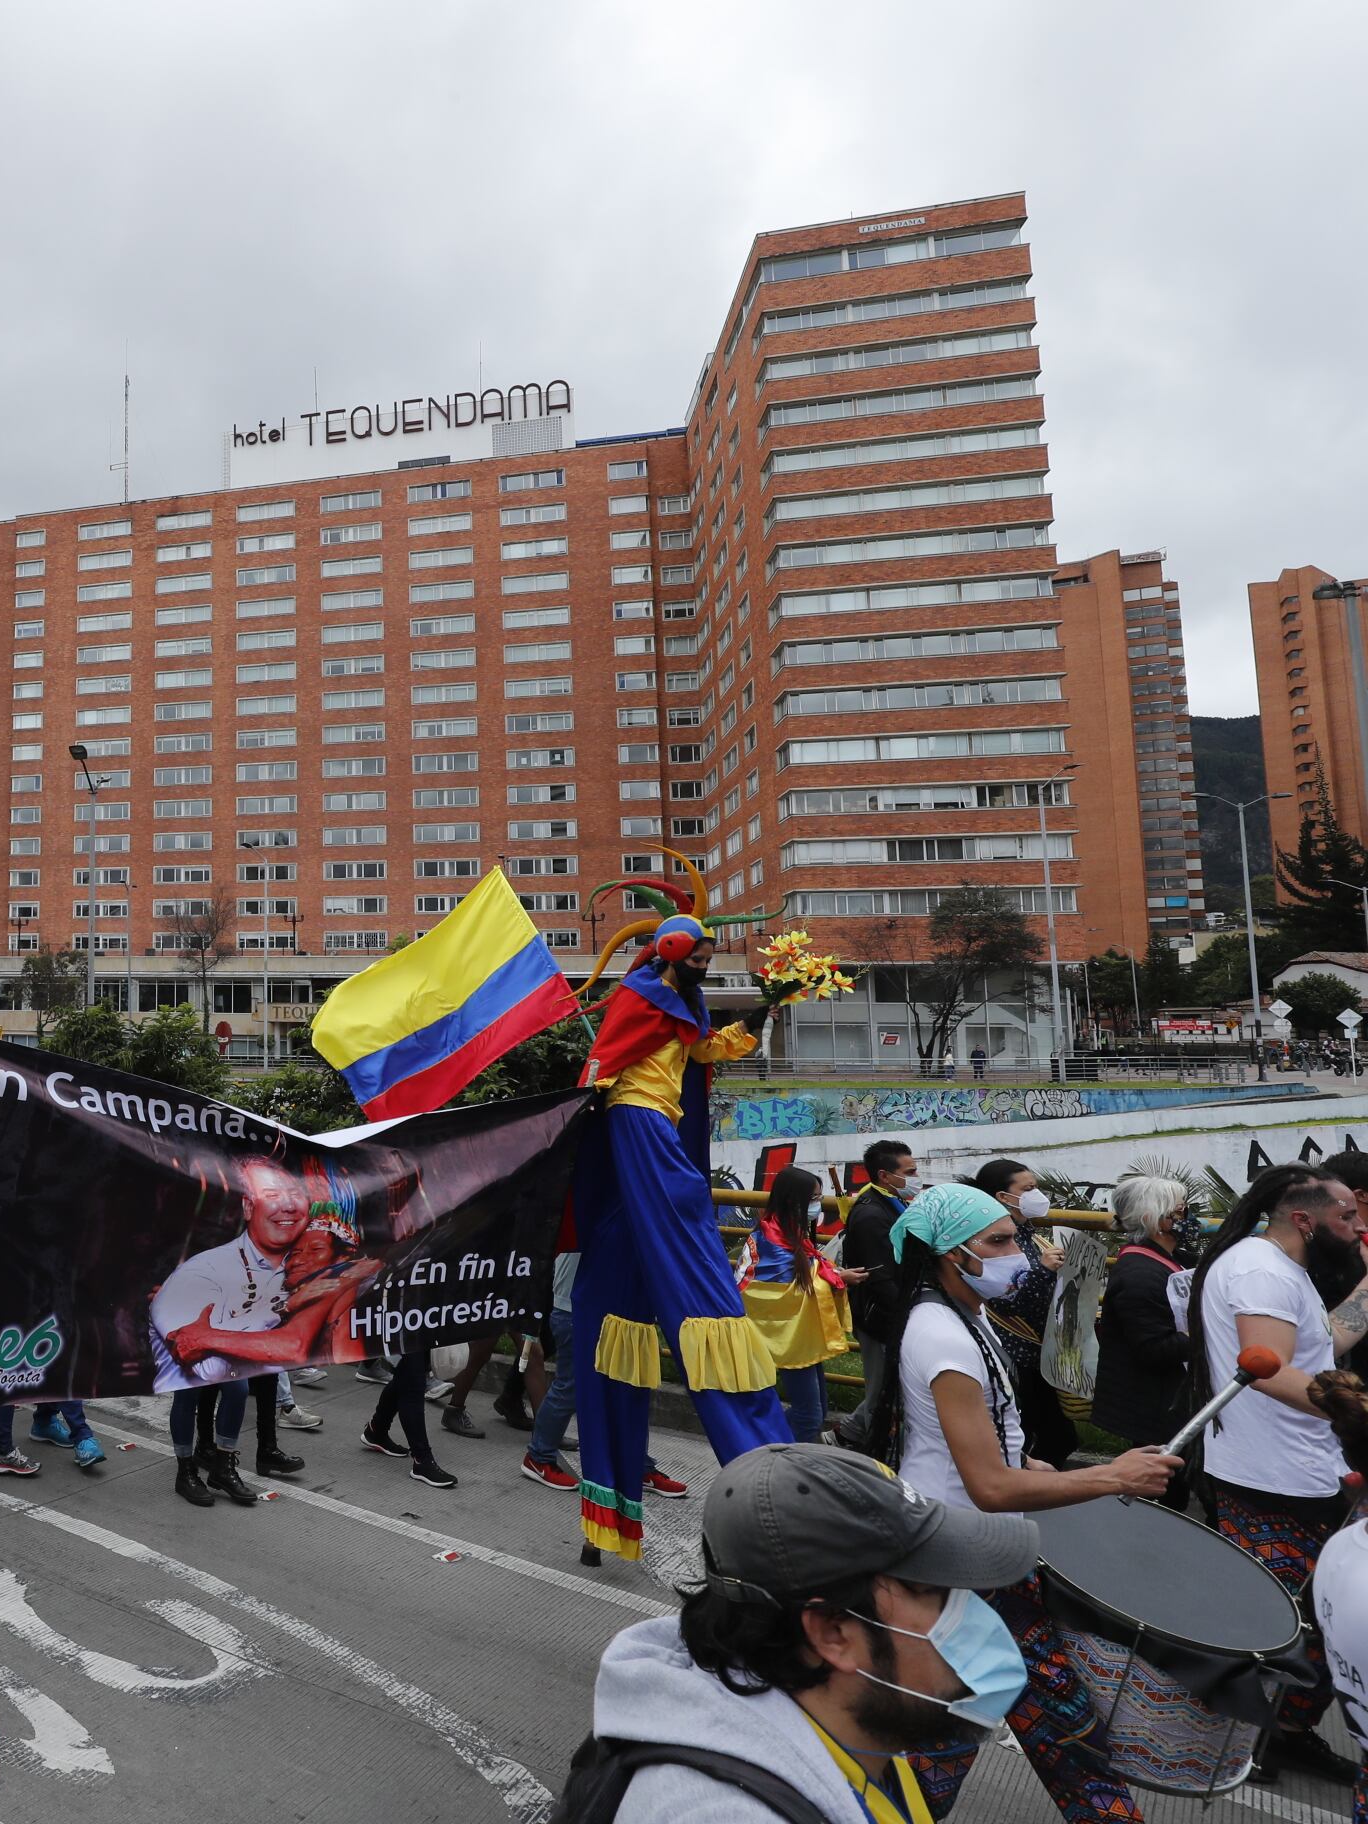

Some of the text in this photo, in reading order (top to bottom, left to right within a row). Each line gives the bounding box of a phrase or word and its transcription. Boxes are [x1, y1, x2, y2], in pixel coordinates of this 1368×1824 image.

[233, 379, 571, 448] hotel TEQUENDAMA
[458, 1253, 496, 1282] fin
[507, 1250, 532, 1277] la
